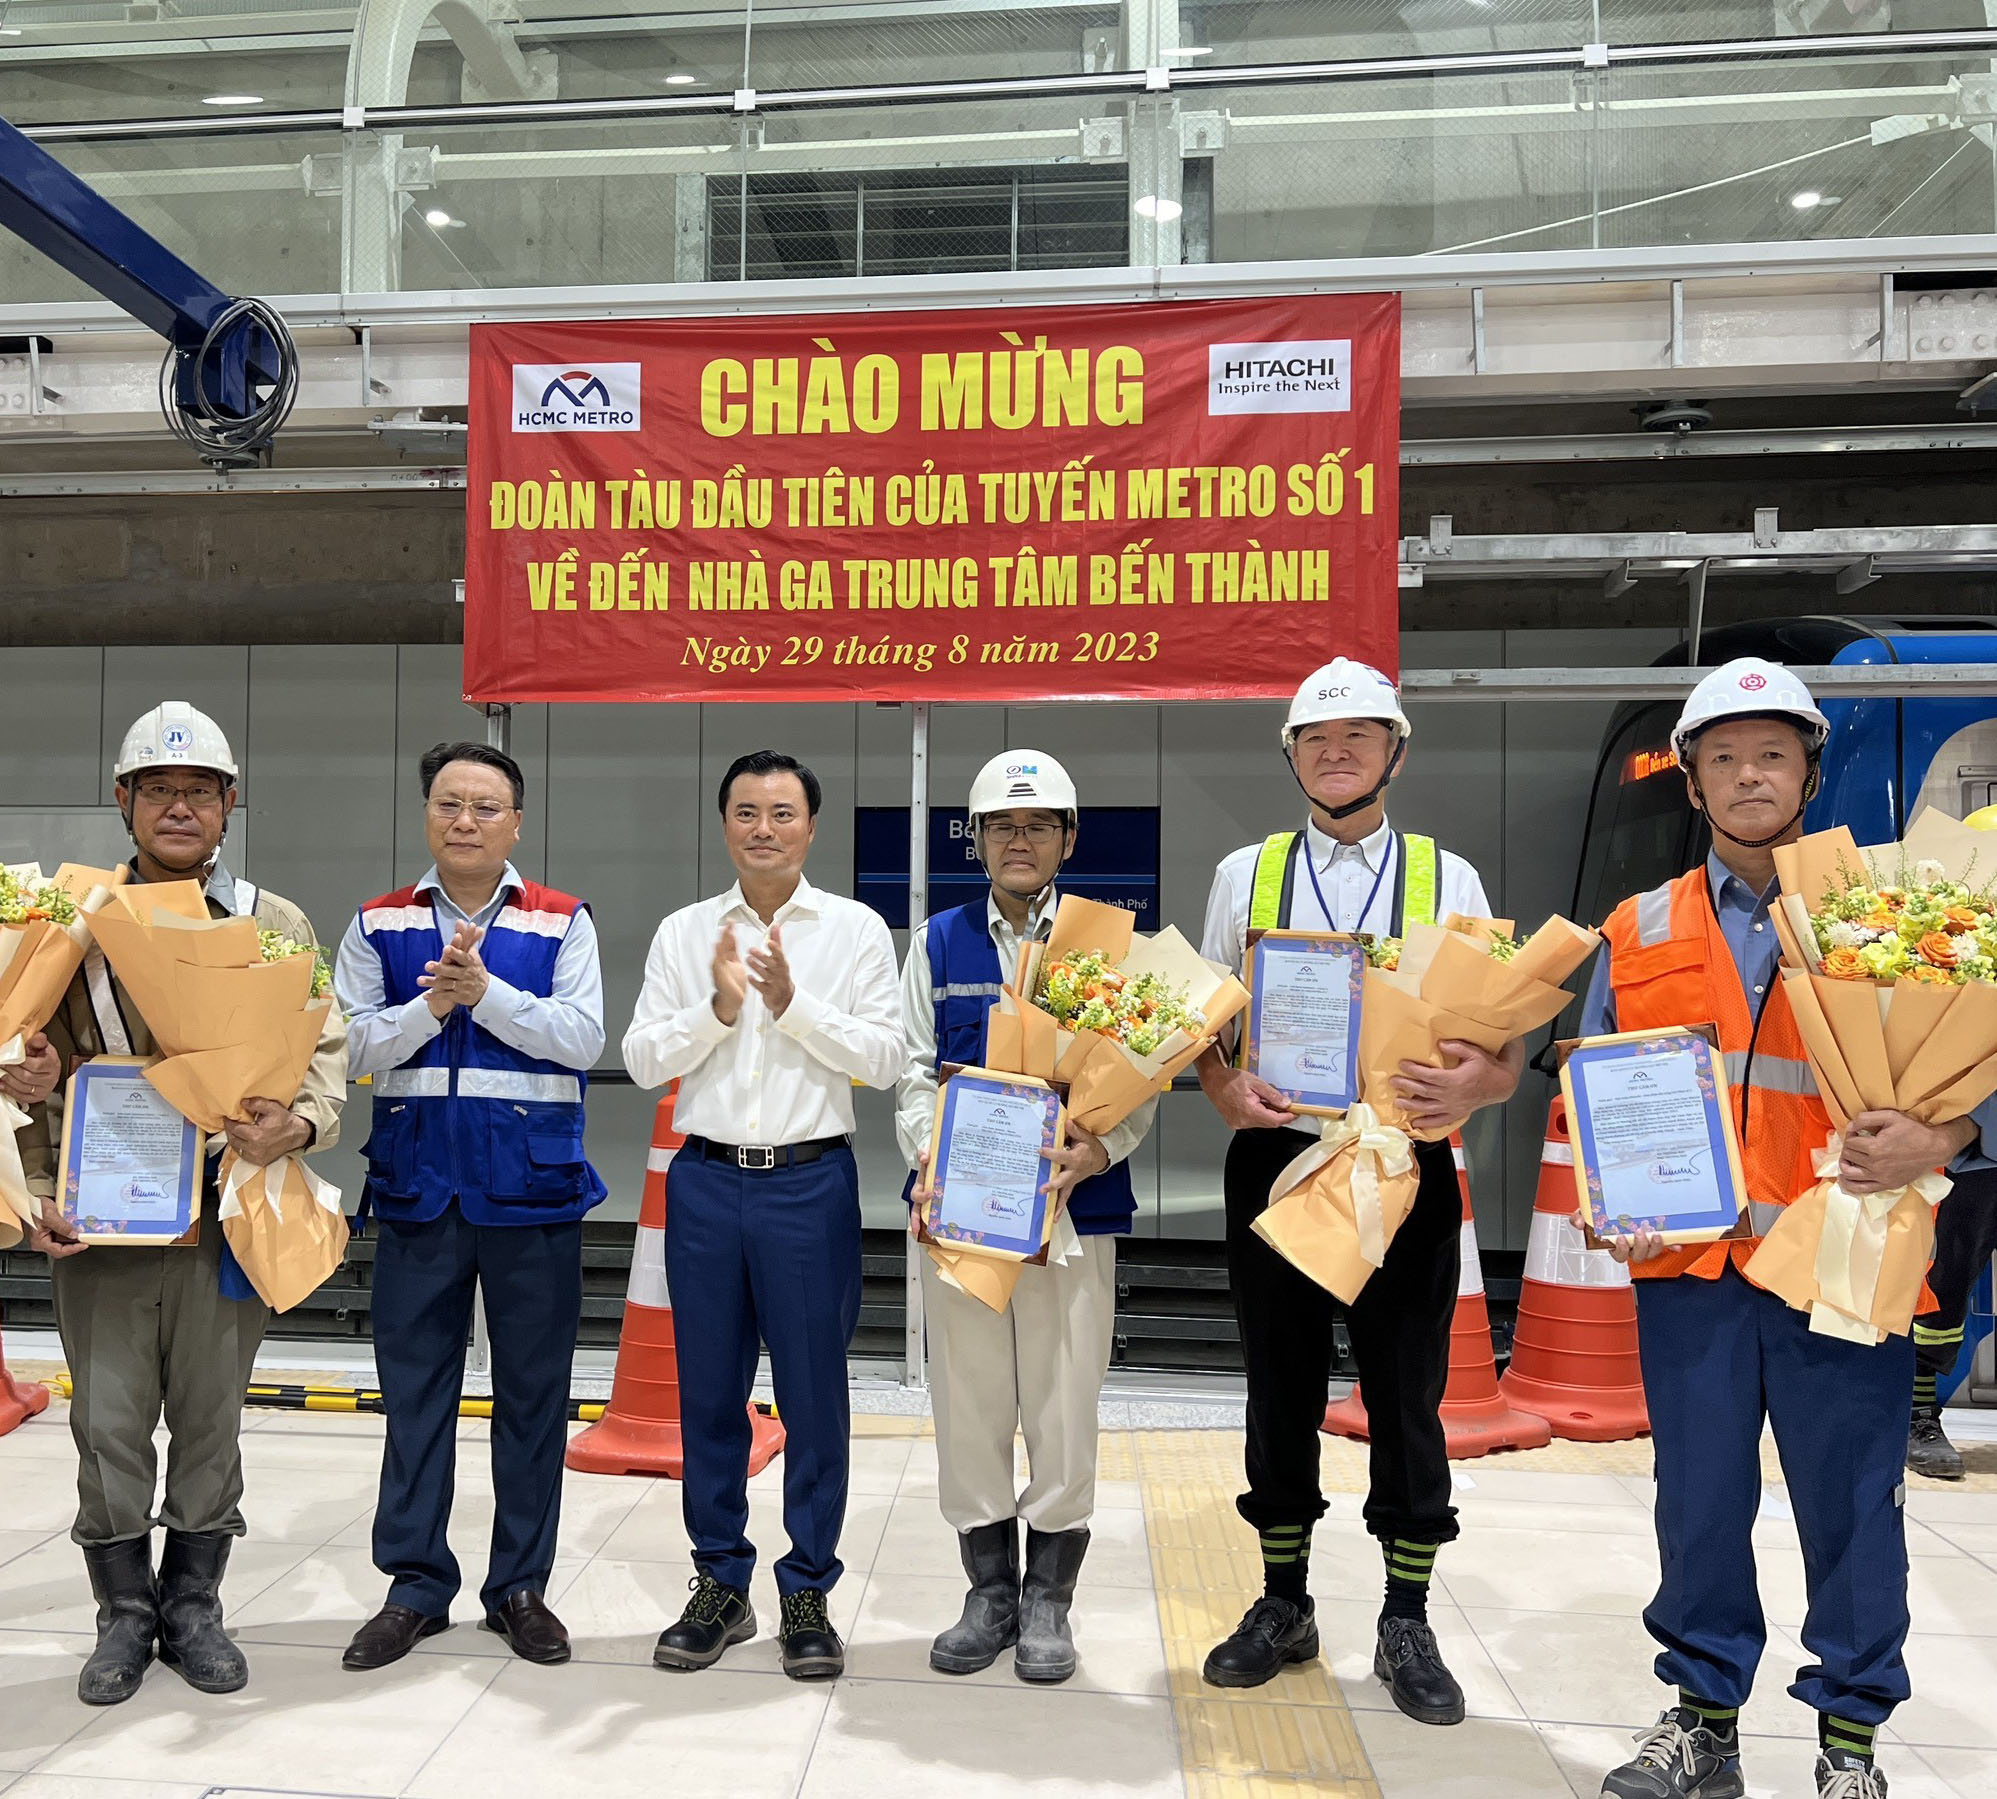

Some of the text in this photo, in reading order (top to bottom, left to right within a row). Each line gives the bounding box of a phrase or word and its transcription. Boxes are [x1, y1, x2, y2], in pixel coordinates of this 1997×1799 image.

[1225, 358, 1334, 379] HITACHI
[700, 331, 1144, 438] CHÀO MỪNG
[1218, 377, 1341, 395] Inspire the Next
[519, 411, 634, 426] HCMC METRO
[489, 447, 1374, 531] ĐOÀN TÀU ĐẦU TIÊN CỦA TUYẾN METRO SỐ 1
[526, 537, 1330, 611] VỀ ĐẾN NHÀ GA TRUNG TÂM BẾN THÀNH
[679, 631, 1160, 673] Ngày 29 tháng 8 năm 2023
[1318, 686, 1351, 701] SCC
[169, 731, 184, 743] JV
[1127, 897, 1149, 910] Phố
